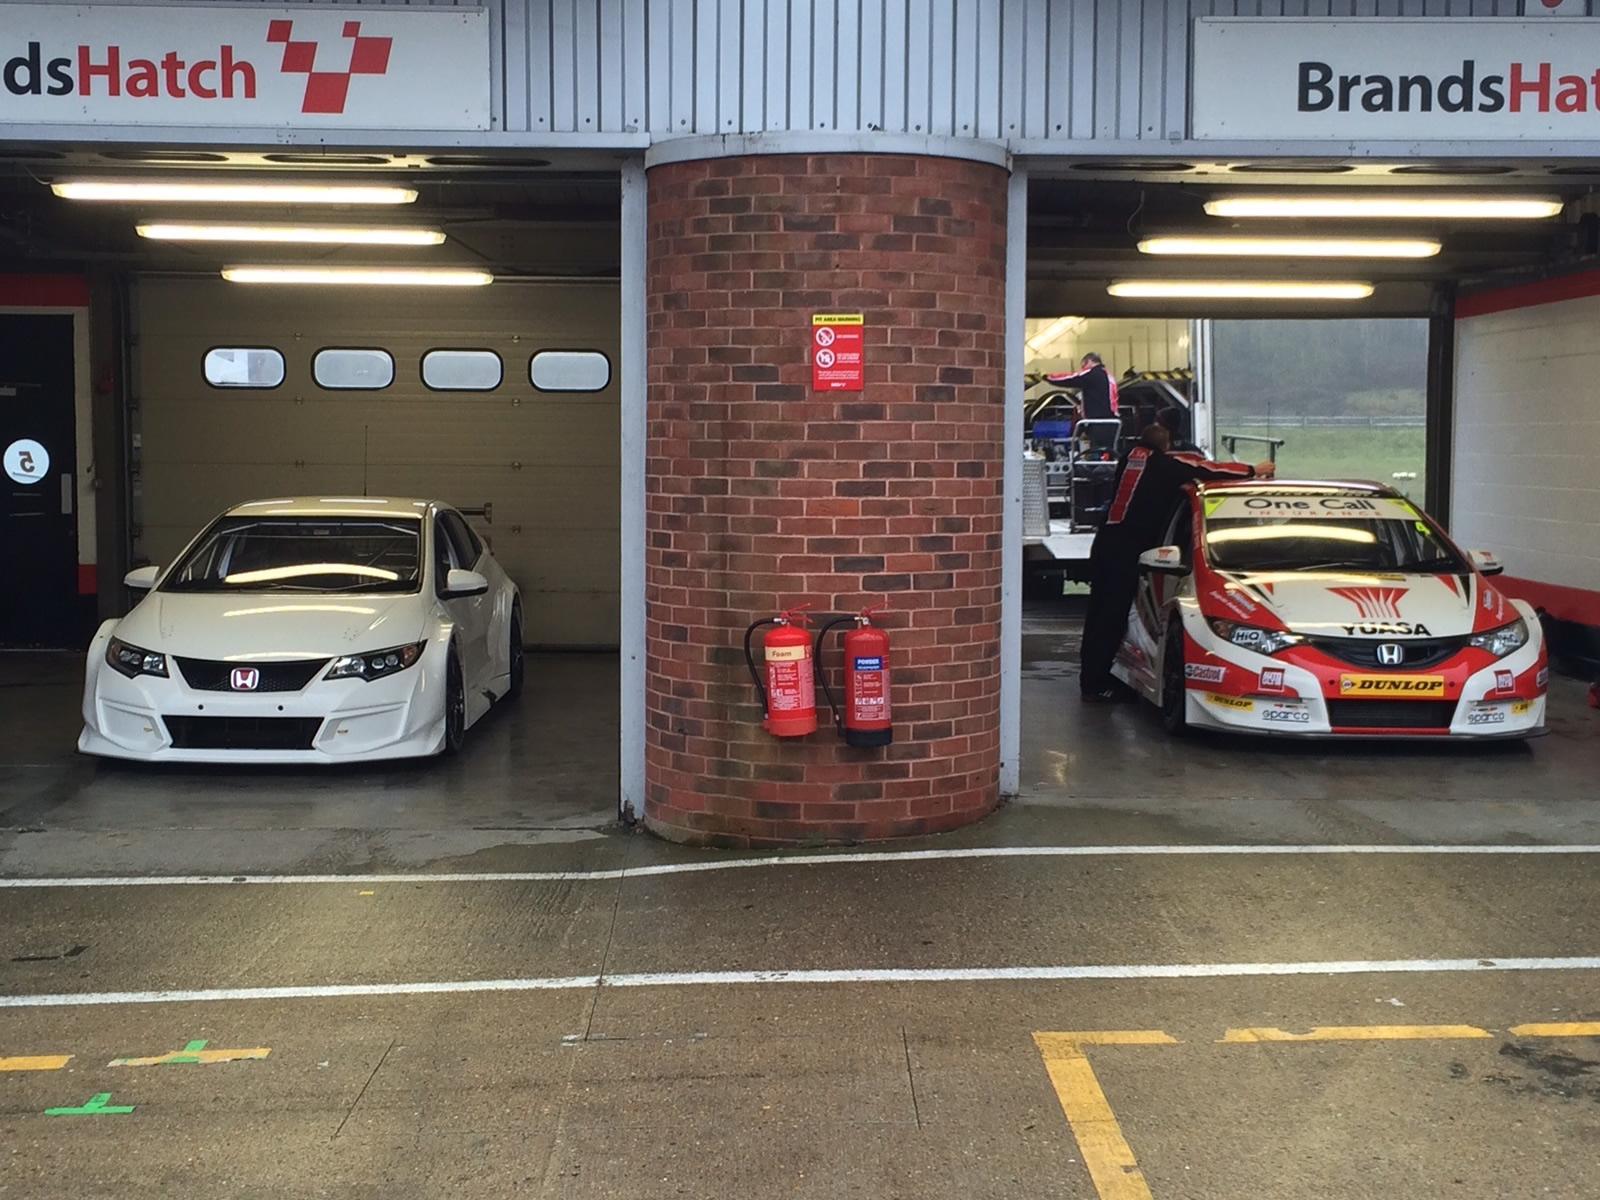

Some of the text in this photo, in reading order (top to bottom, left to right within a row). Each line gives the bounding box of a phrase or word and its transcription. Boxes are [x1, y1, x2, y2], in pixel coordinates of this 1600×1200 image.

[1244, 498, 1376, 510] One Call
[1343, 622, 1432, 636] YUASA
[1358, 680, 1443, 691] DUNLOP
[1215, 695, 1252, 707] DUNLOP
